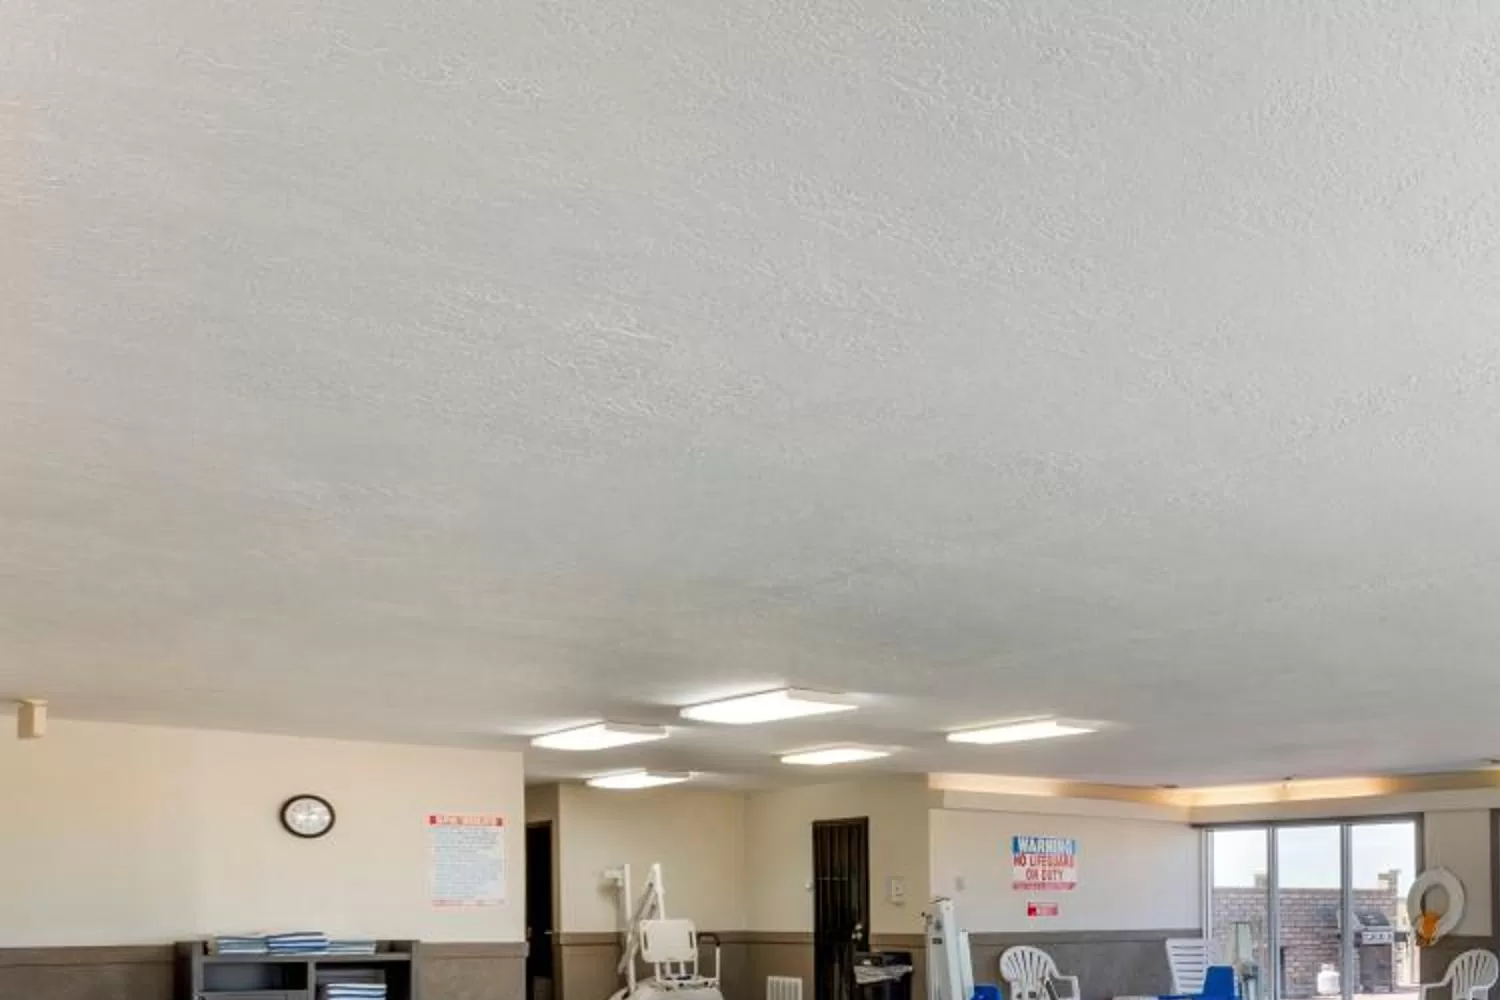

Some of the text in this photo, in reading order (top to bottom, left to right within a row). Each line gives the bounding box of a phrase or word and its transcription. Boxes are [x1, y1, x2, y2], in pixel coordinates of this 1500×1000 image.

[1020, 836, 1073, 854] WARNING
[1014, 854, 1074, 868] NO LIFEGUARD
[1026, 868, 1062, 881] ON DUTY
